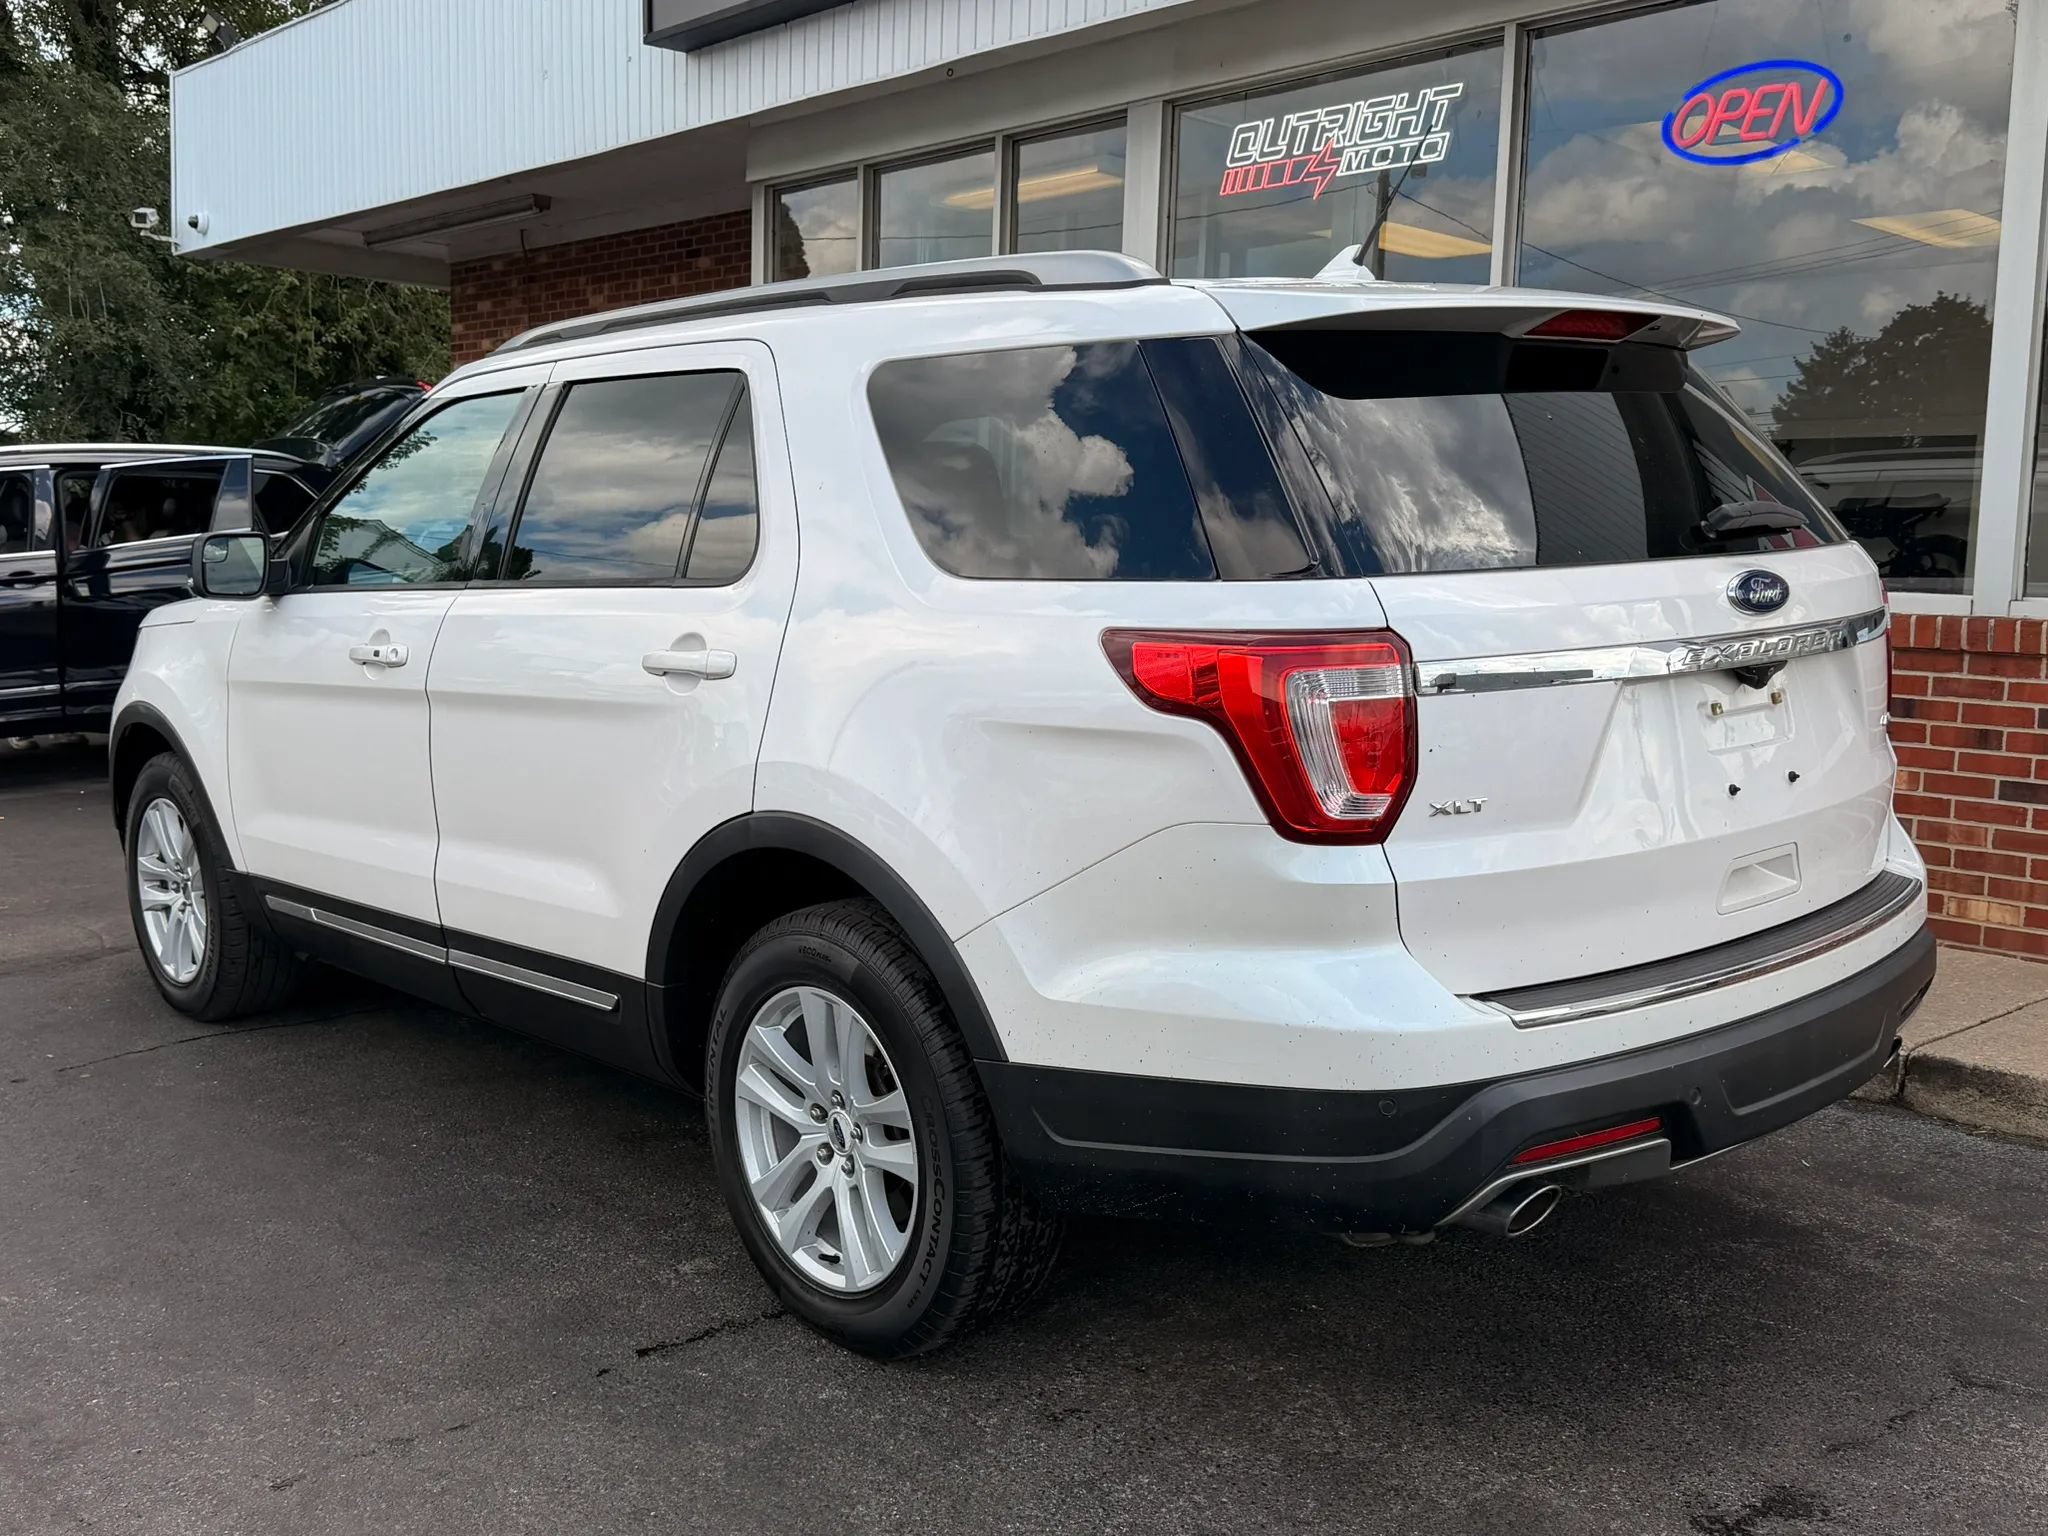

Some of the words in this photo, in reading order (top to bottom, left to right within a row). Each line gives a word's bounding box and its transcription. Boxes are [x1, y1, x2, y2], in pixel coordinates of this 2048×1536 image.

[1226, 82, 1464, 168] OUTRIGHT
[1671, 78, 1830, 149] OPEN
[1342, 137, 1443, 173] MOTO
[1749, 576, 1783, 604] Ford
[1683, 629, 1843, 666] EXPLORER
[1428, 797, 1489, 818] XLT
